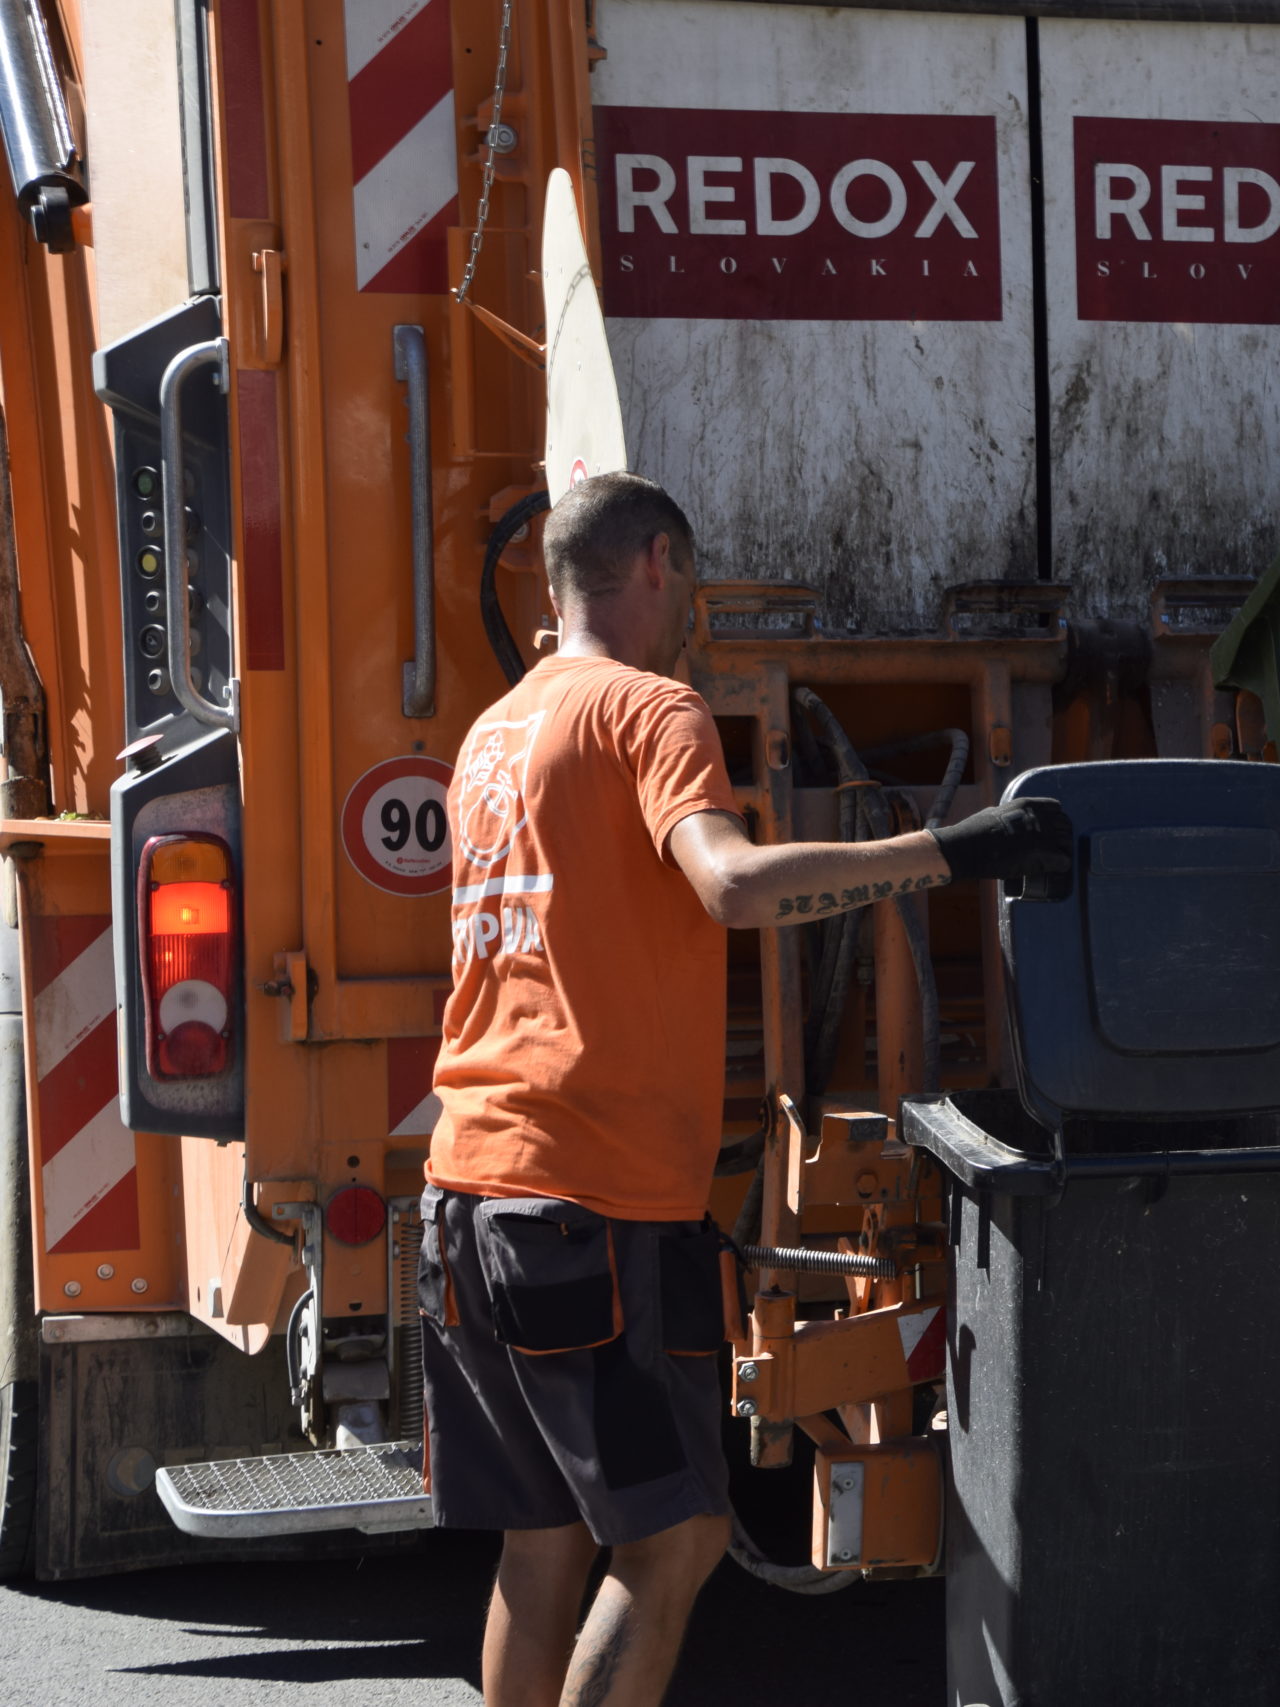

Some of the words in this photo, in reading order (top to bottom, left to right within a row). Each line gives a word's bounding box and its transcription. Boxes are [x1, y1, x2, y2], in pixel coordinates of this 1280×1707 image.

[614, 153, 979, 239] REDOX
[619, 254, 979, 277] SLOVAKIA
[380, 798, 447, 852] 90
